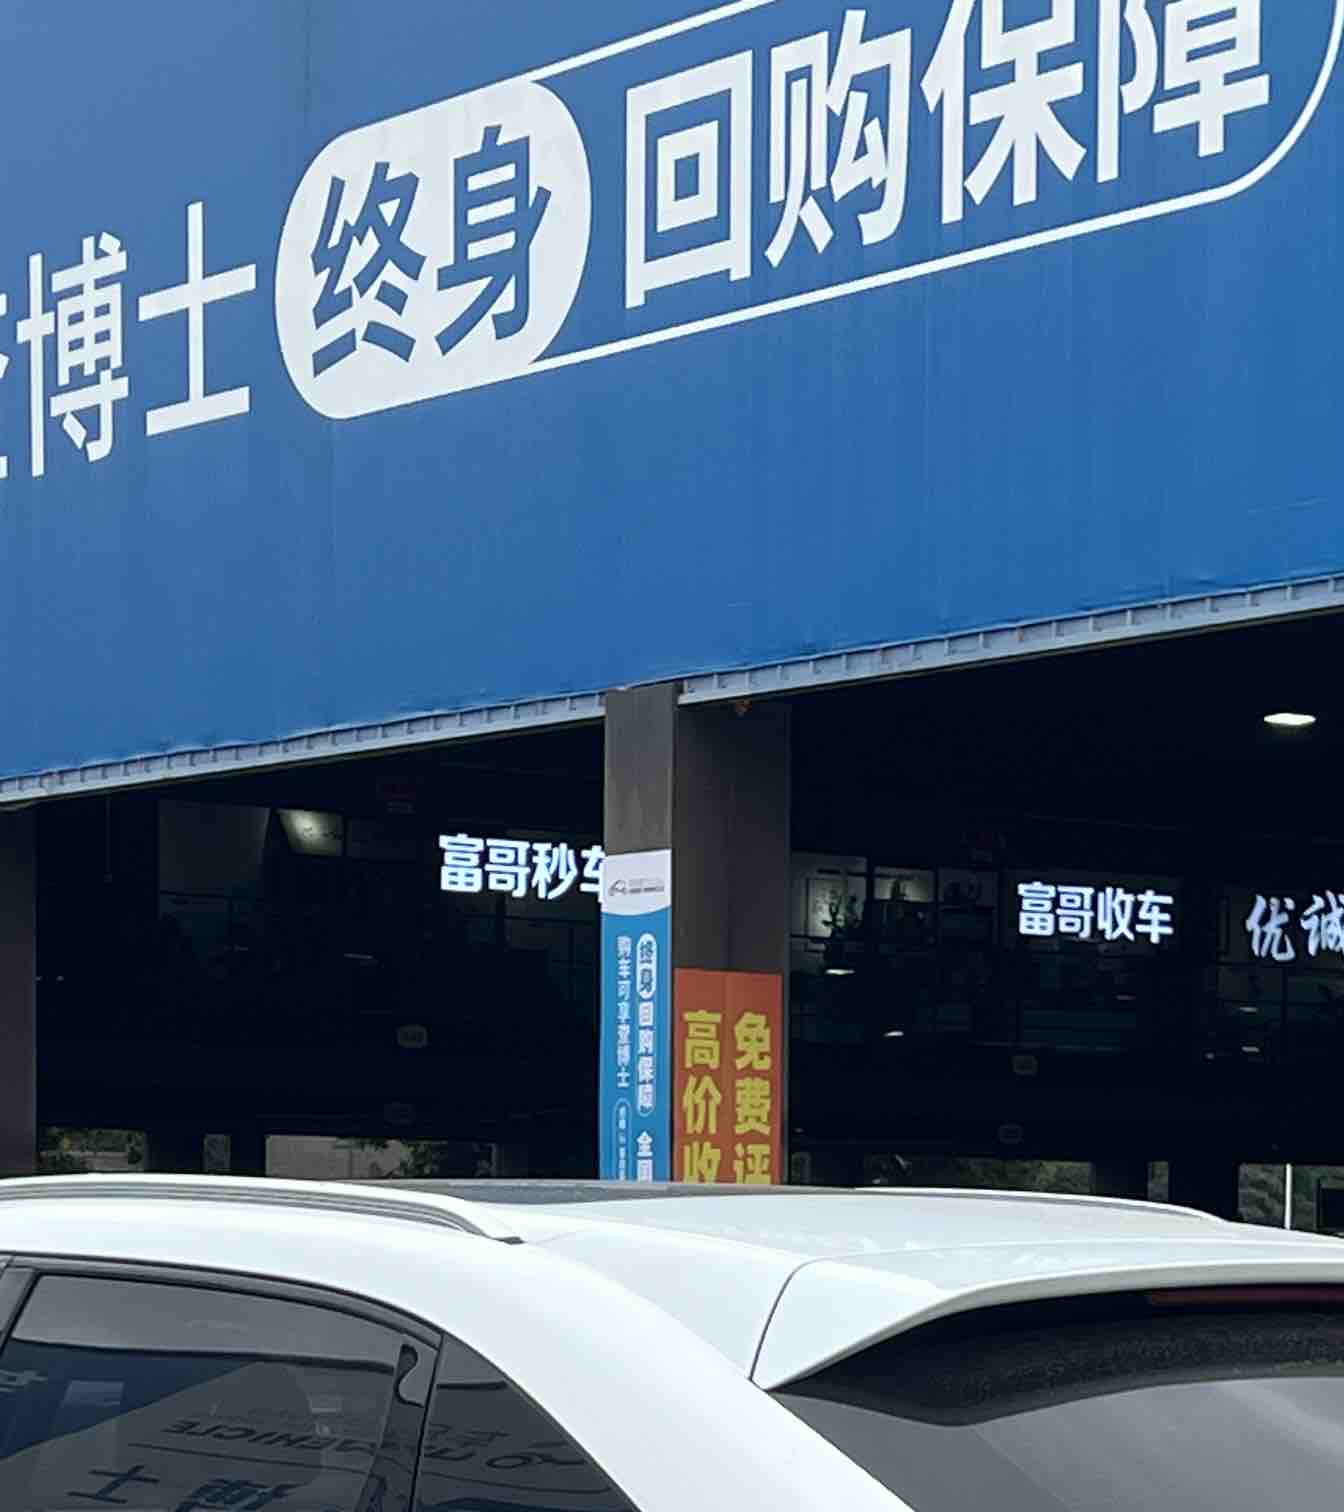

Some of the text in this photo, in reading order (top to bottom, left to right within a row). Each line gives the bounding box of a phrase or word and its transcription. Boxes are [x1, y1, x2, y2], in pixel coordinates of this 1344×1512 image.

[311, 124, 553, 379] 终身
[624, 0, 1270, 309] 回购保障
[1017, 881, 1174, 944] 富哥收车
